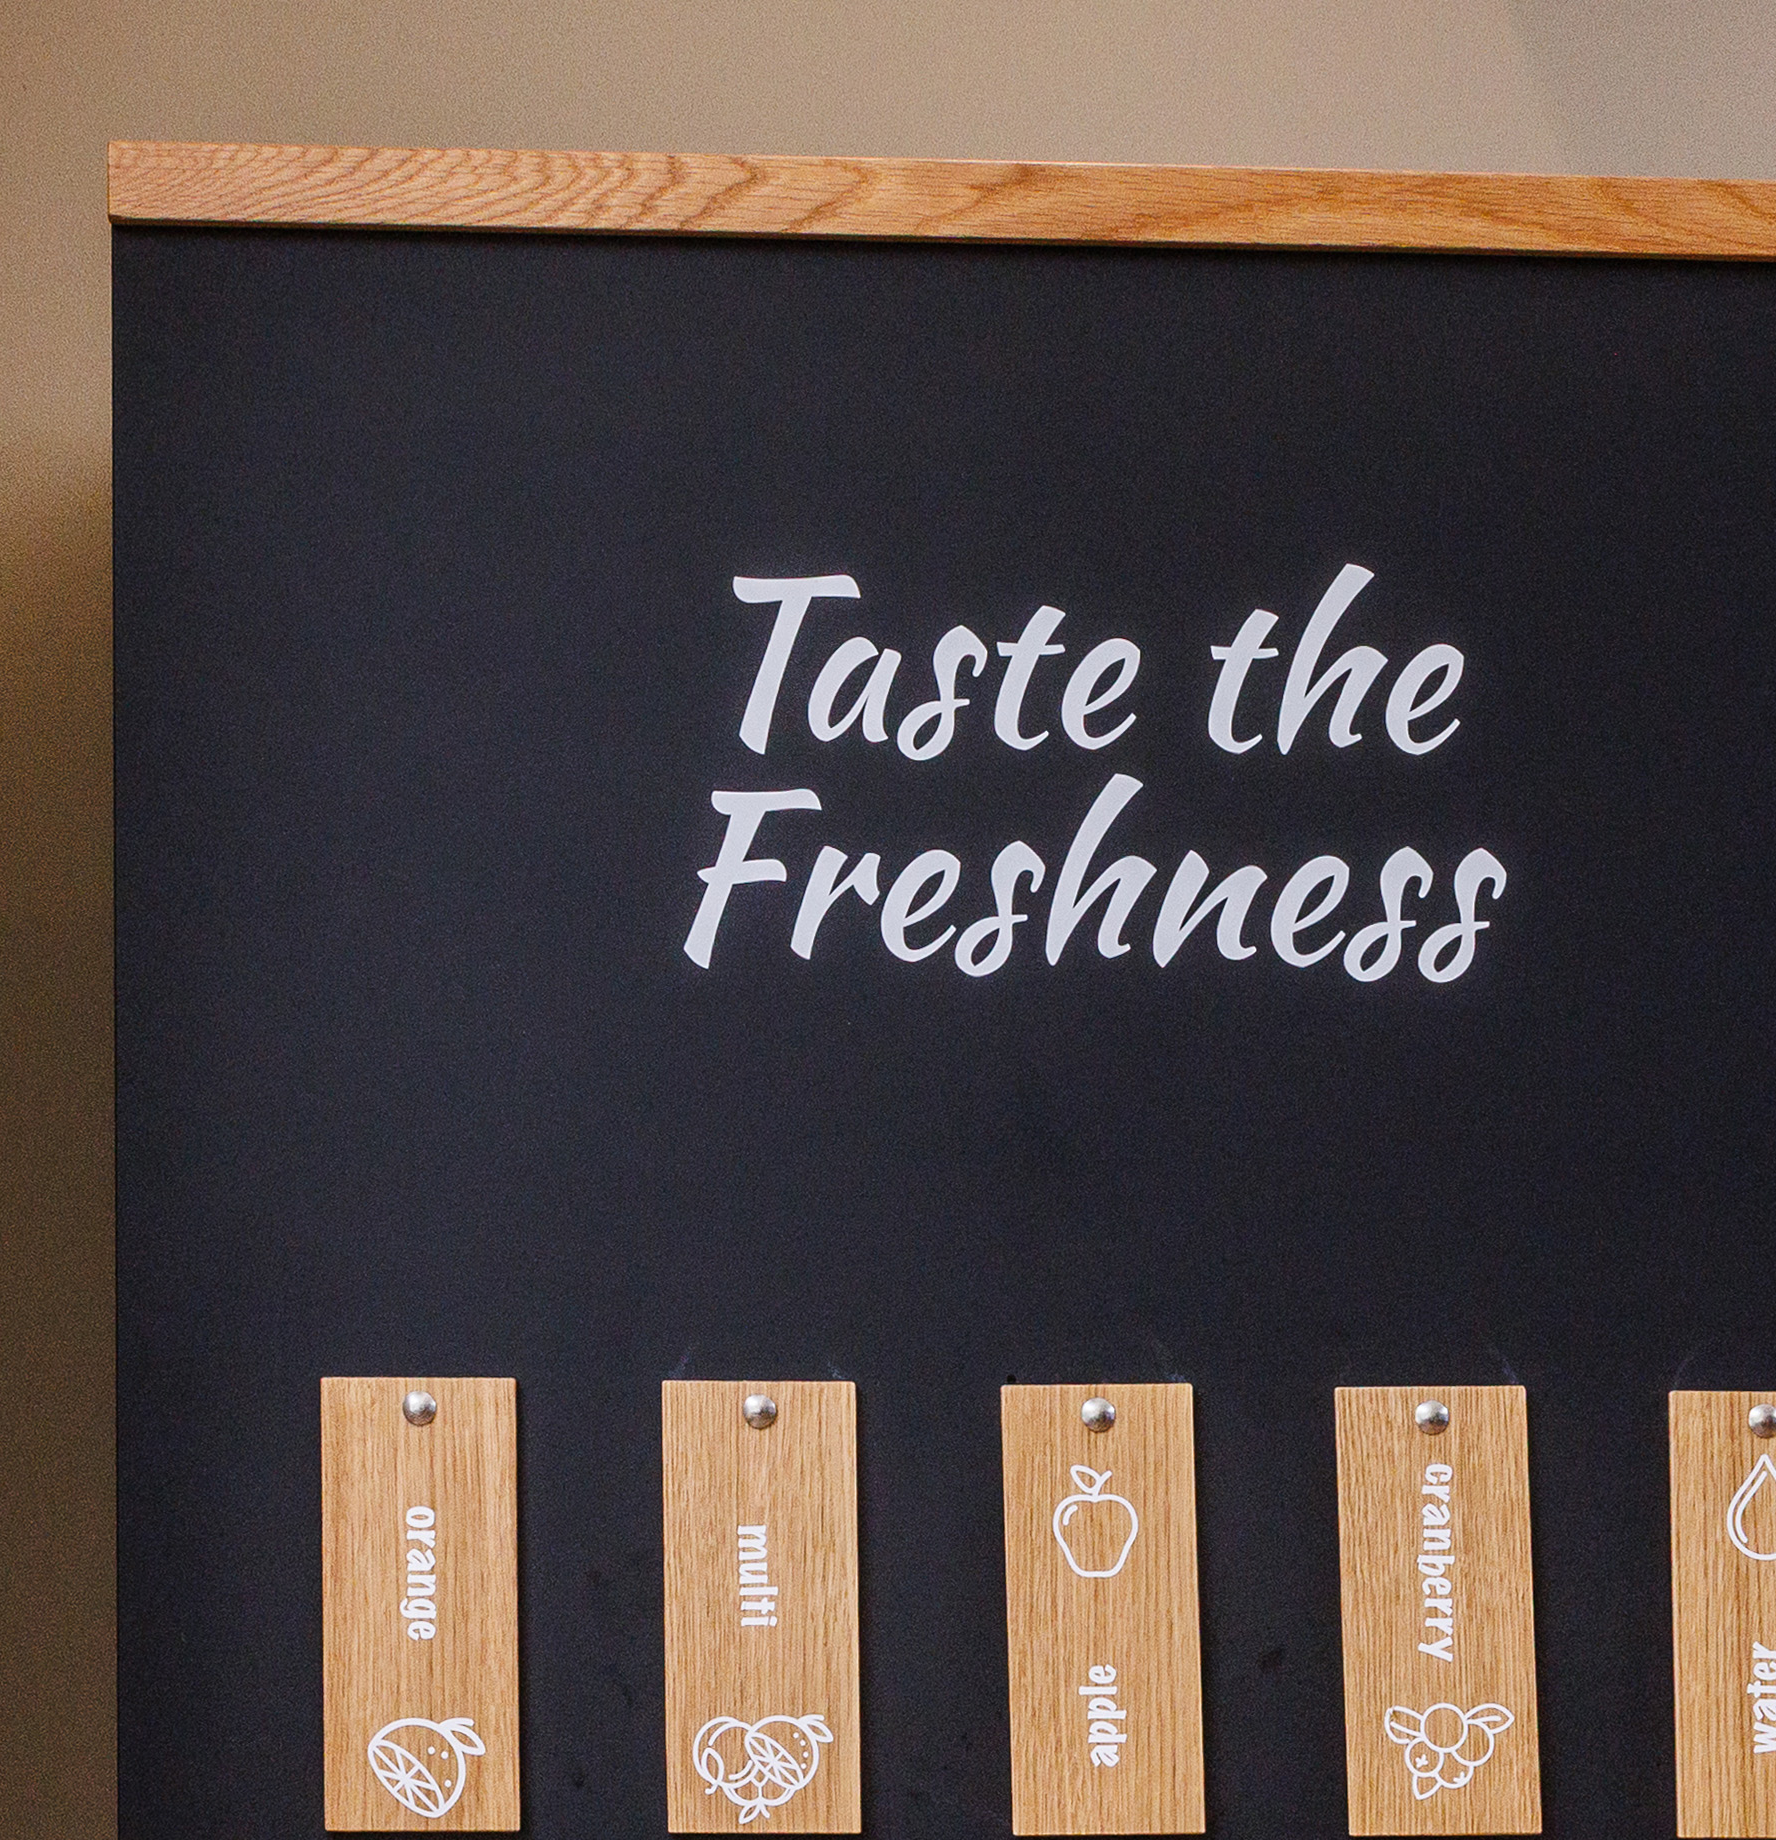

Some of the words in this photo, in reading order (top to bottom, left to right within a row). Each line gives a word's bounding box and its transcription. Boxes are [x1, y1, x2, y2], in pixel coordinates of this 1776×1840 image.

[732, 574, 1141, 761] Taste
[1207, 562, 1465, 756] the
[682, 773, 1507, 984] Freshness
[400, 1504, 437, 1641] orange
[737, 1523, 779, 1628] multi
[1417, 1463, 1455, 1663] cranberry
[1078, 1663, 1128, 1768] apple
